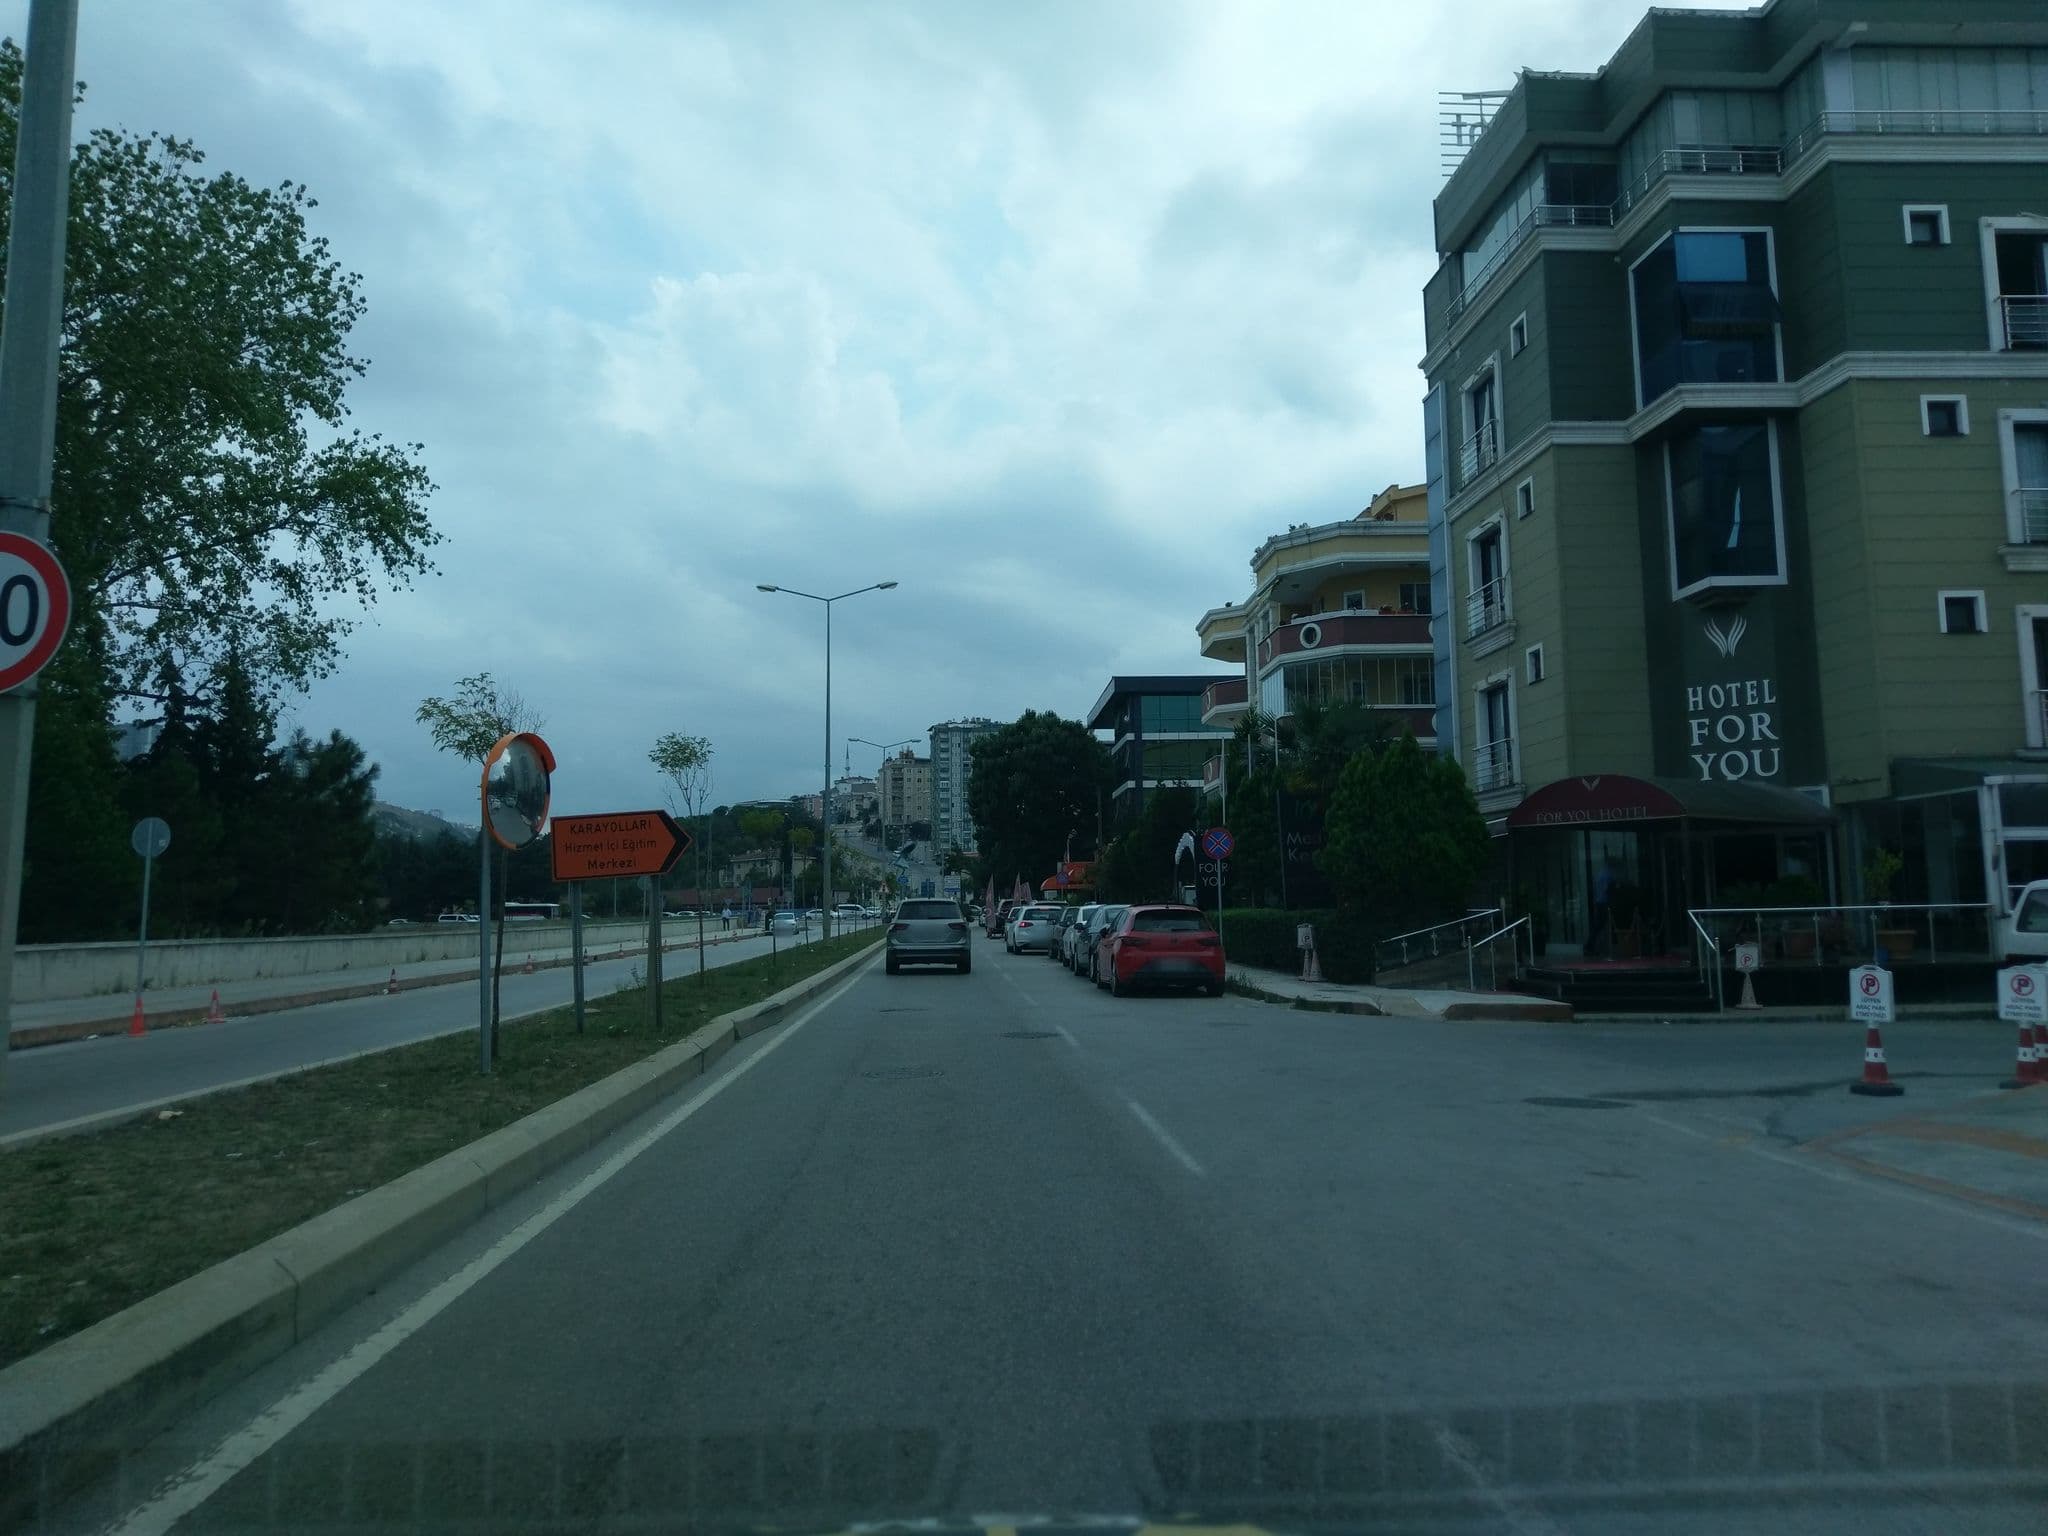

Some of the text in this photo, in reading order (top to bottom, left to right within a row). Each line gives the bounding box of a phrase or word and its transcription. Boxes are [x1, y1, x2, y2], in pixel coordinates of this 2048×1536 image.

[1687, 679, 1777, 711] HOTEL
[1688, 712, 1780, 747] FOR
[1690, 747, 1781, 781] YOU
[569, 819, 652, 835] KARAYOLLARI
[565, 841, 603, 854] Hizmet
[622, 838, 657, 852] Eğitim
[587, 858, 637, 871] Merkezi
